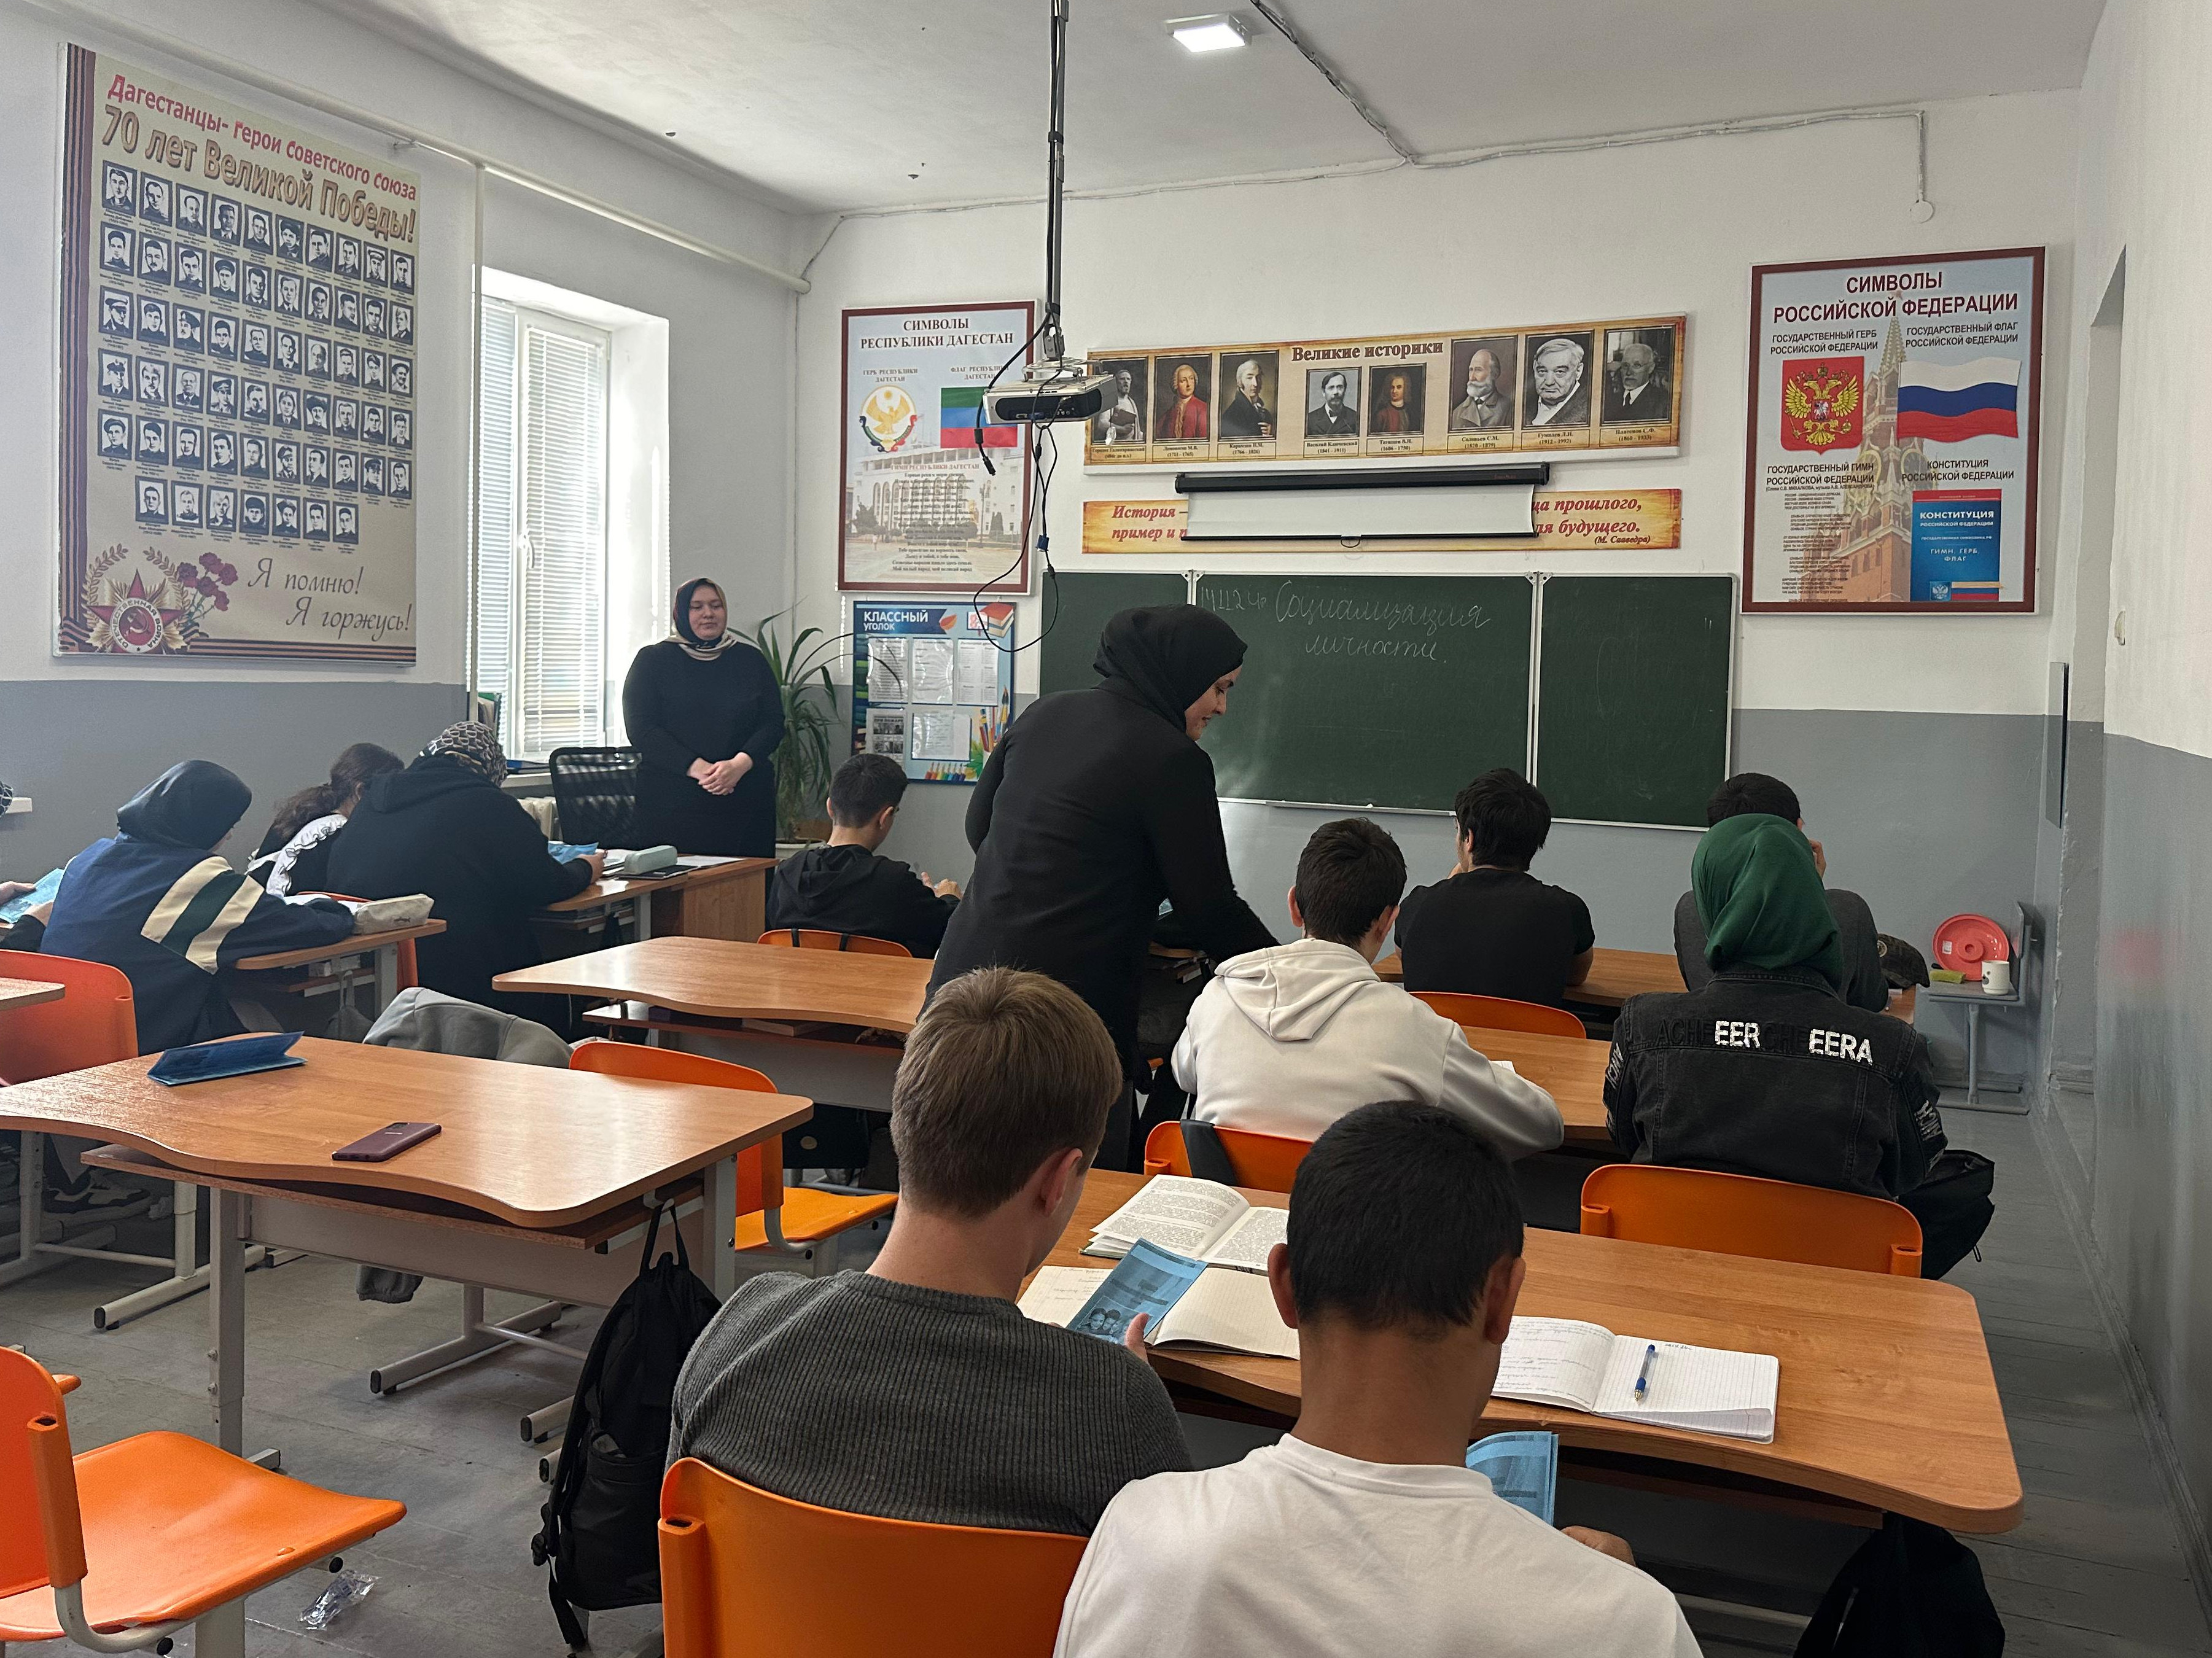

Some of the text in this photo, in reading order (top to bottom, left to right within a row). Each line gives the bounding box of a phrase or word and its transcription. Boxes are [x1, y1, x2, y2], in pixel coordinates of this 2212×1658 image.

[107, 74, 229, 133] Дагестанцы-
[101, 103, 140, 154] 70
[144, 128, 198, 170] лет
[203, 139, 314, 211] Великой
[319, 178, 417, 244] Победы!
[1846, 271, 1943, 294] СИМВОЛЫ
[1773, 293, 2019, 324] РОССИЙСКОЙ ФЕДЕРАЦИИ
[903, 318, 969, 331] СИМВОЛЫ
[1906, 322, 2019, 337] ГОСУДАРСТВЕННЫЙ ФЛАГ
[861, 333, 1014, 349] РЕСПУБЛИКИ ДАГЕСТАН
[1772, 329, 1877, 344] ГОСУДАРСТВЕННЫЙ ГЕРБ
[1905, 334, 2019, 348] РОССИЙСКОЙ ФЕДЕРАЦИИ
[1291, 341, 1443, 362] Великие историки
[1770, 341, 1878, 355] РОССИЙСКОЙ ФЕДЕРАЦИИ
[1767, 461, 1874, 475] ГОСУДАРСТВЕННЫЙ ГИМН
[1927, 459, 1989, 469] КОНСТИТУЦИЯ
[1766, 474, 1874, 486] РОССИЙСКОЙ ФЕДЕРАЦИИ
[1901, 470, 2014, 482] РОССИЙСКОЙ ФЕДЕРАЦИИ
[1112, 505, 1176, 521] История
[1554, 498, 1641, 515] прошлого,
[1920, 511, 1994, 520] КОНСТИТУЦИЯ
[1112, 527, 1163, 540] пример
[1559, 519, 1640, 537] будущего.
[247, 557, 364, 595] Я помню!
[285, 596, 413, 642] Я горжусь!
[864, 610, 929, 623] КЛАССНЫЙ
[1714, 1020, 1761, 1049] EER
[1809, 1028, 1873, 1066] EERA
